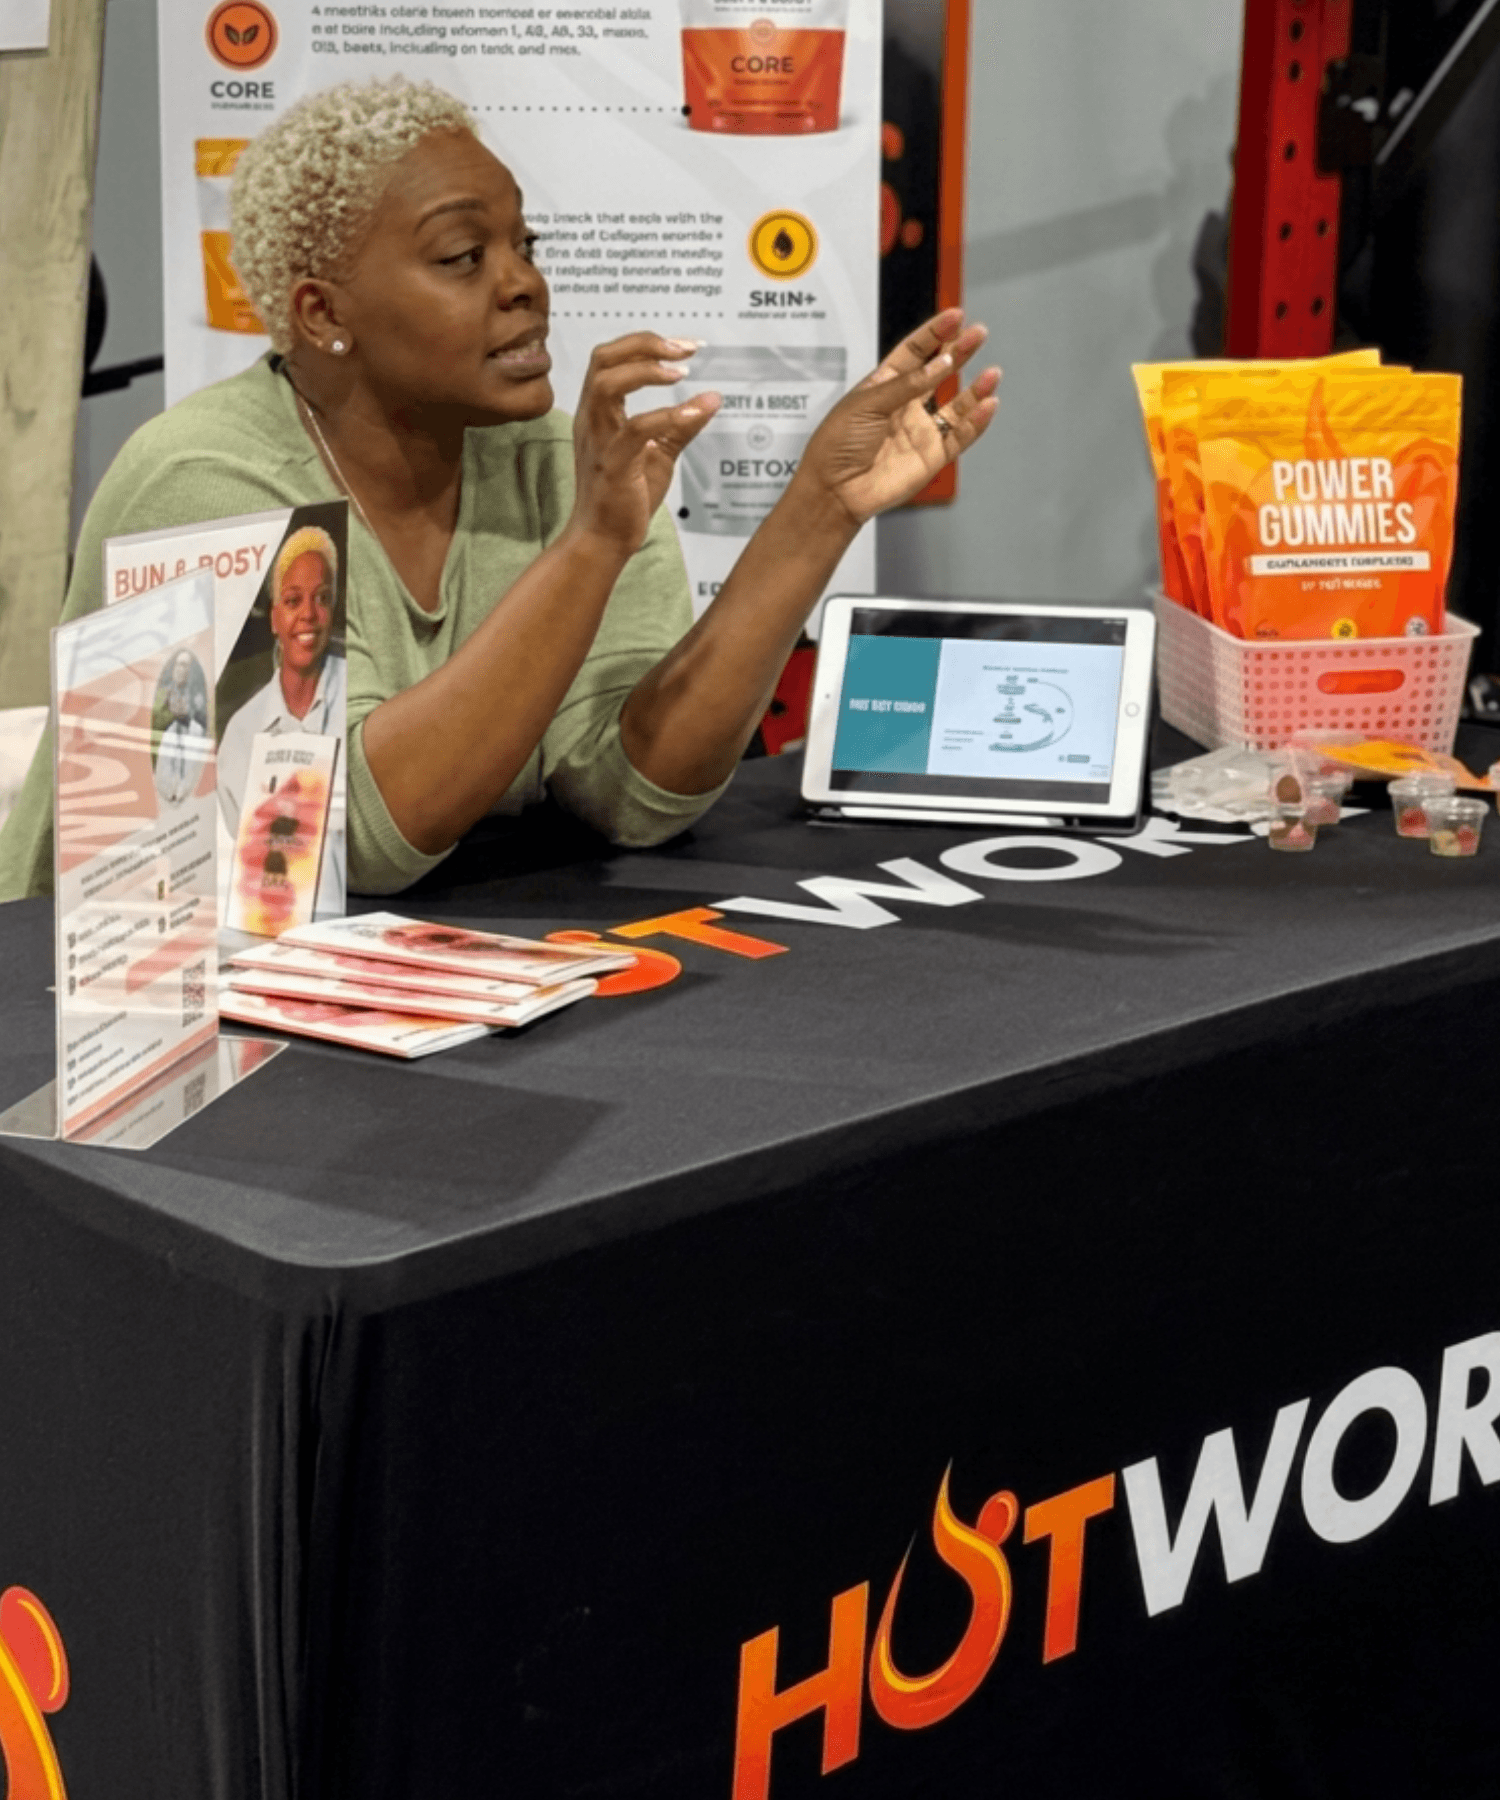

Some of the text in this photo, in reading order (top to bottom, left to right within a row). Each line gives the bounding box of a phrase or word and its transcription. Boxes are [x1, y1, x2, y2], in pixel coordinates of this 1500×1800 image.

[731, 56, 794, 73] CORE
[210, 81, 275, 99] CORE
[720, 459, 798, 477] DETOX
[1272, 457, 1395, 502] POWER
[1259, 502, 1417, 548] GUMMIES
